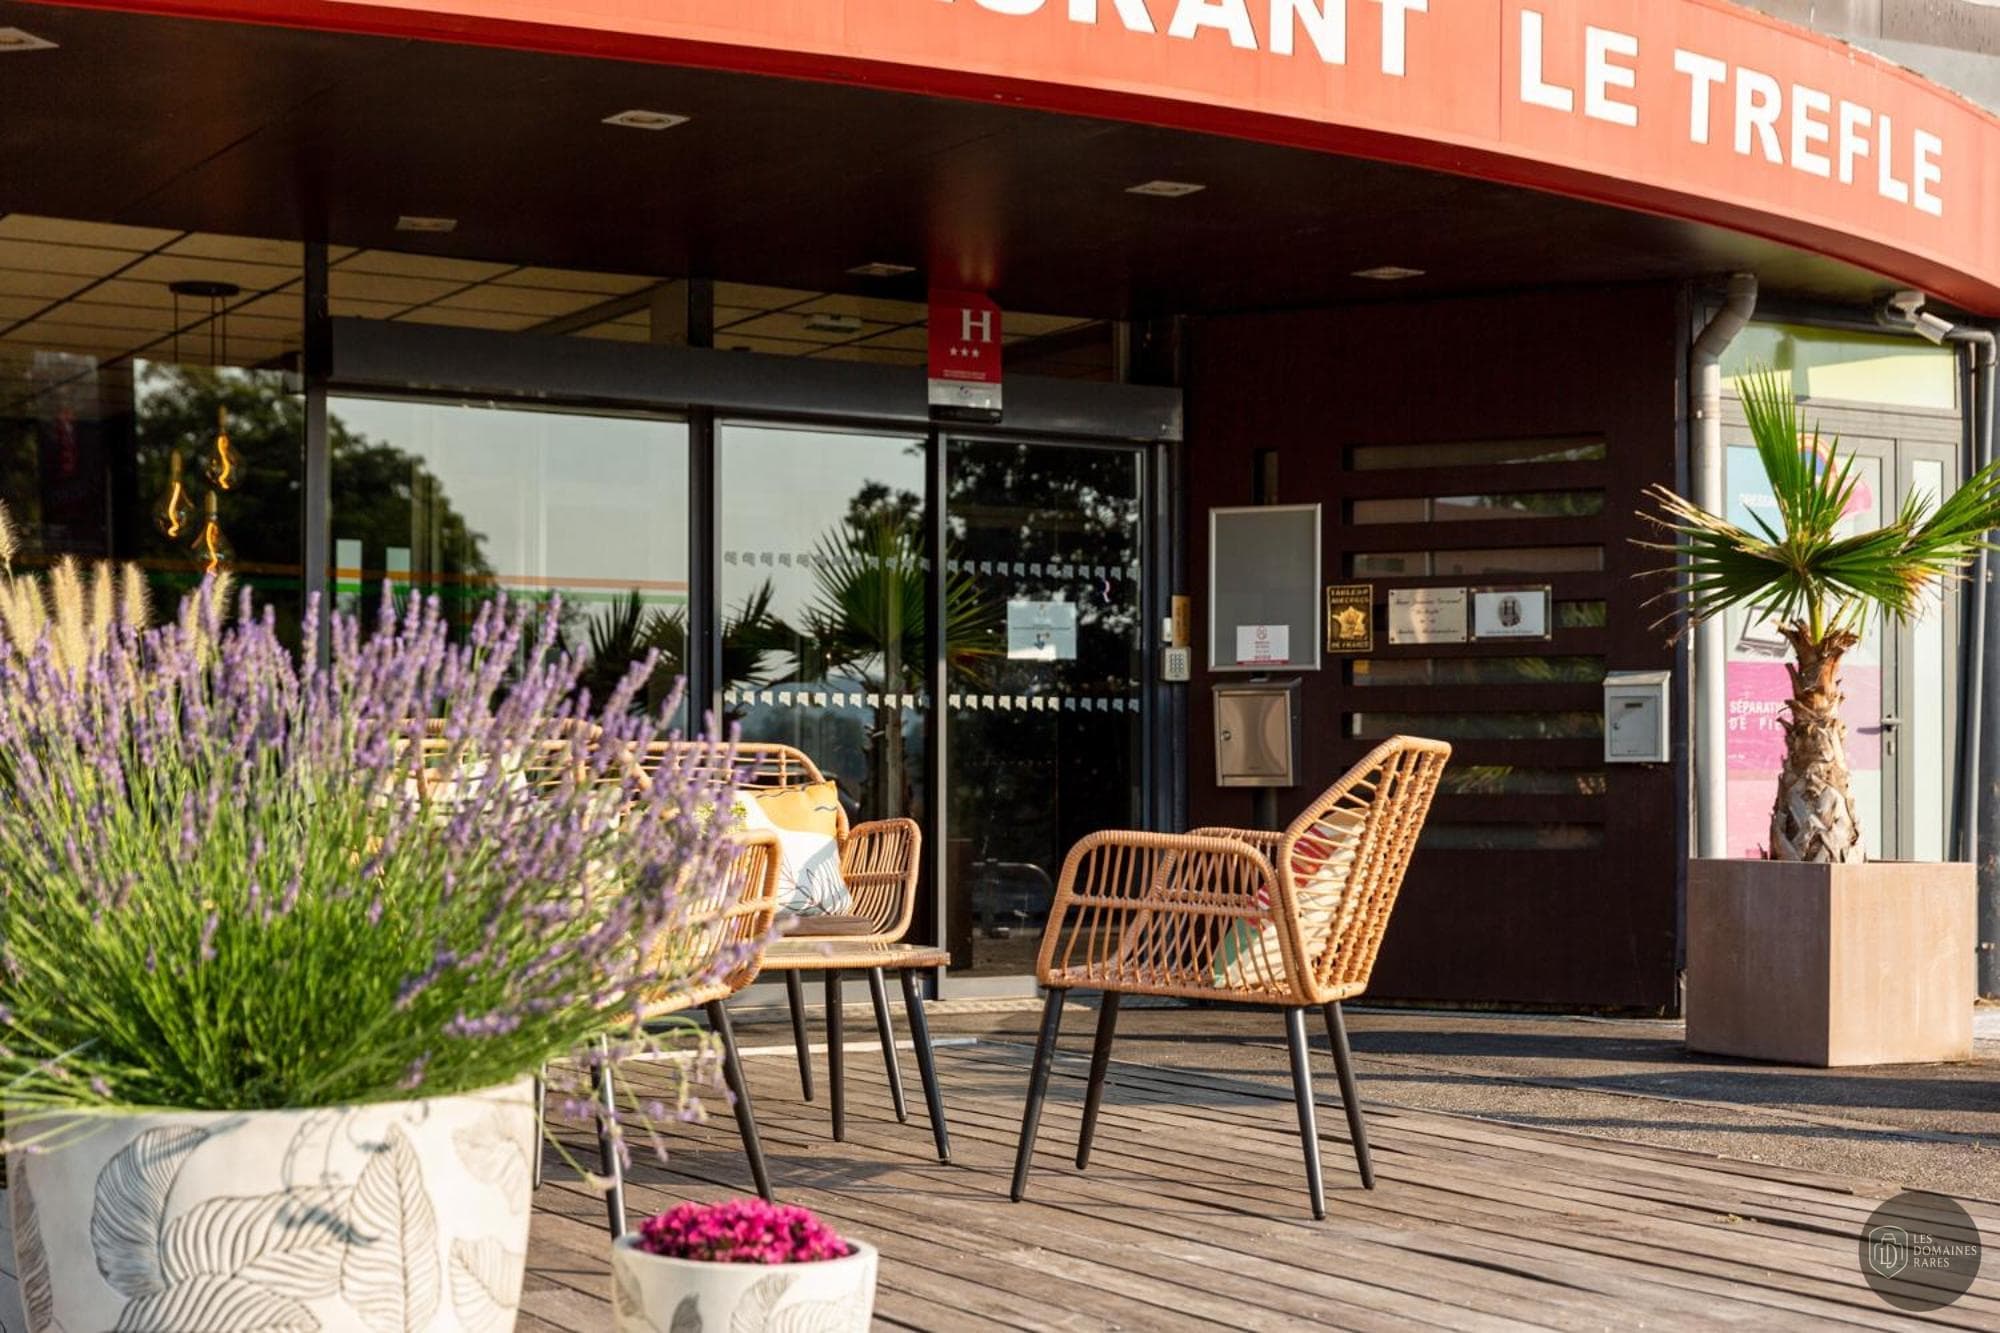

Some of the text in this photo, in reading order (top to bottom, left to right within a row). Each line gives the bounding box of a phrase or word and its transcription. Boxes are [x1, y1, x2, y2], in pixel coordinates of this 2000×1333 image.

[973, 0, 1943, 218] ANT LE TREFLE
[961, 308, 991, 343] H
